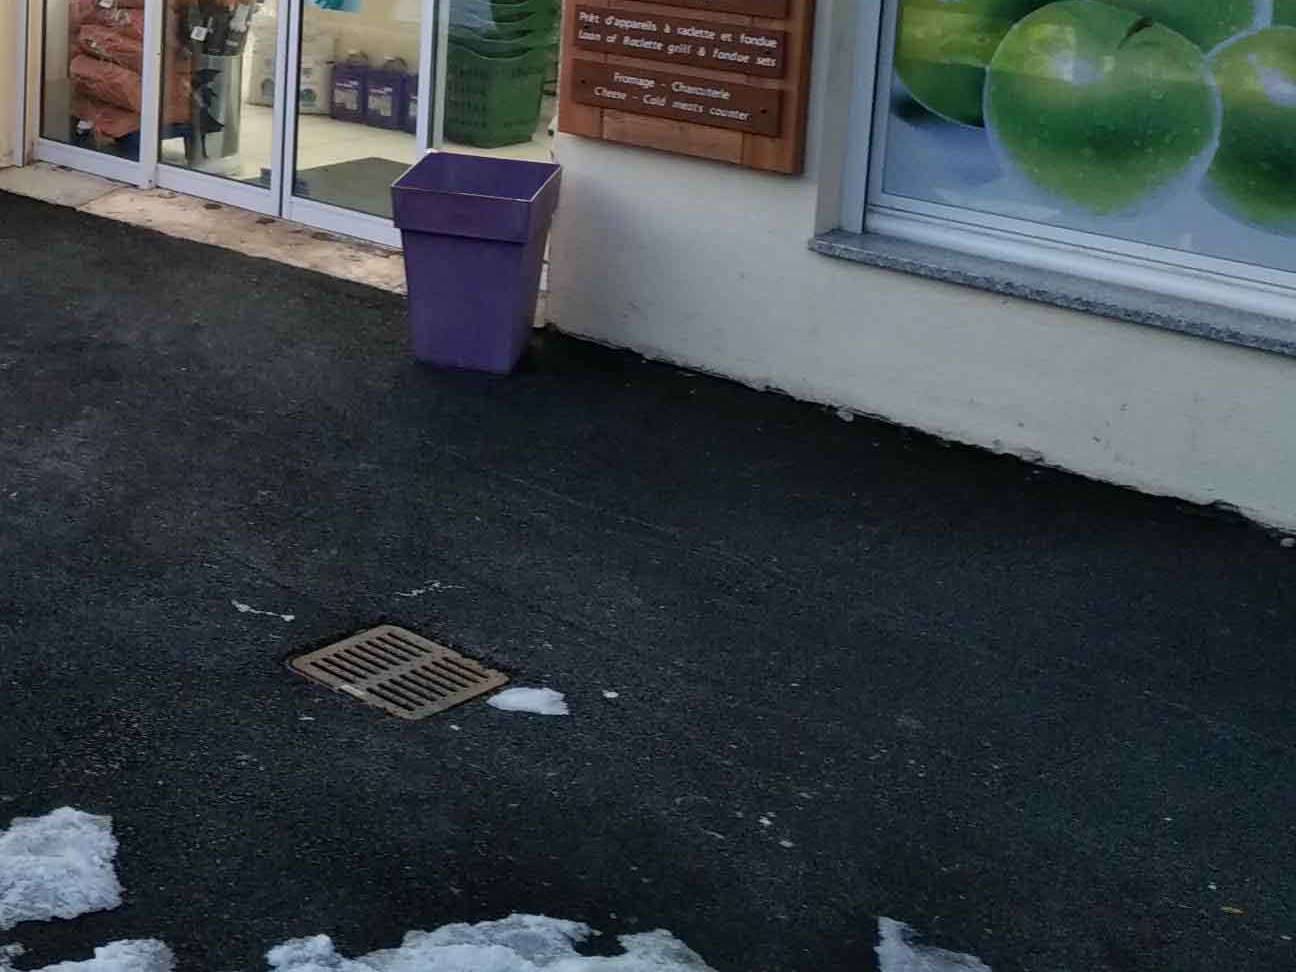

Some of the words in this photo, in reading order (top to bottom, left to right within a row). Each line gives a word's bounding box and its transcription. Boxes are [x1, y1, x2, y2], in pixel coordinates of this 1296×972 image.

[606, 33, 617, 44] of
[712, 49, 750, 64] fondue
[755, 55, 777, 67] sets
[720, 32, 732, 42] et
[740, 33, 777, 48] fondue
[614, 72, 655, 88] Fromage
[594, 87, 627, 100] Cheese
[643, 94, 667, 107] Cold
[672, 100, 704, 113] meats
[709, 107, 750, 120] counter
